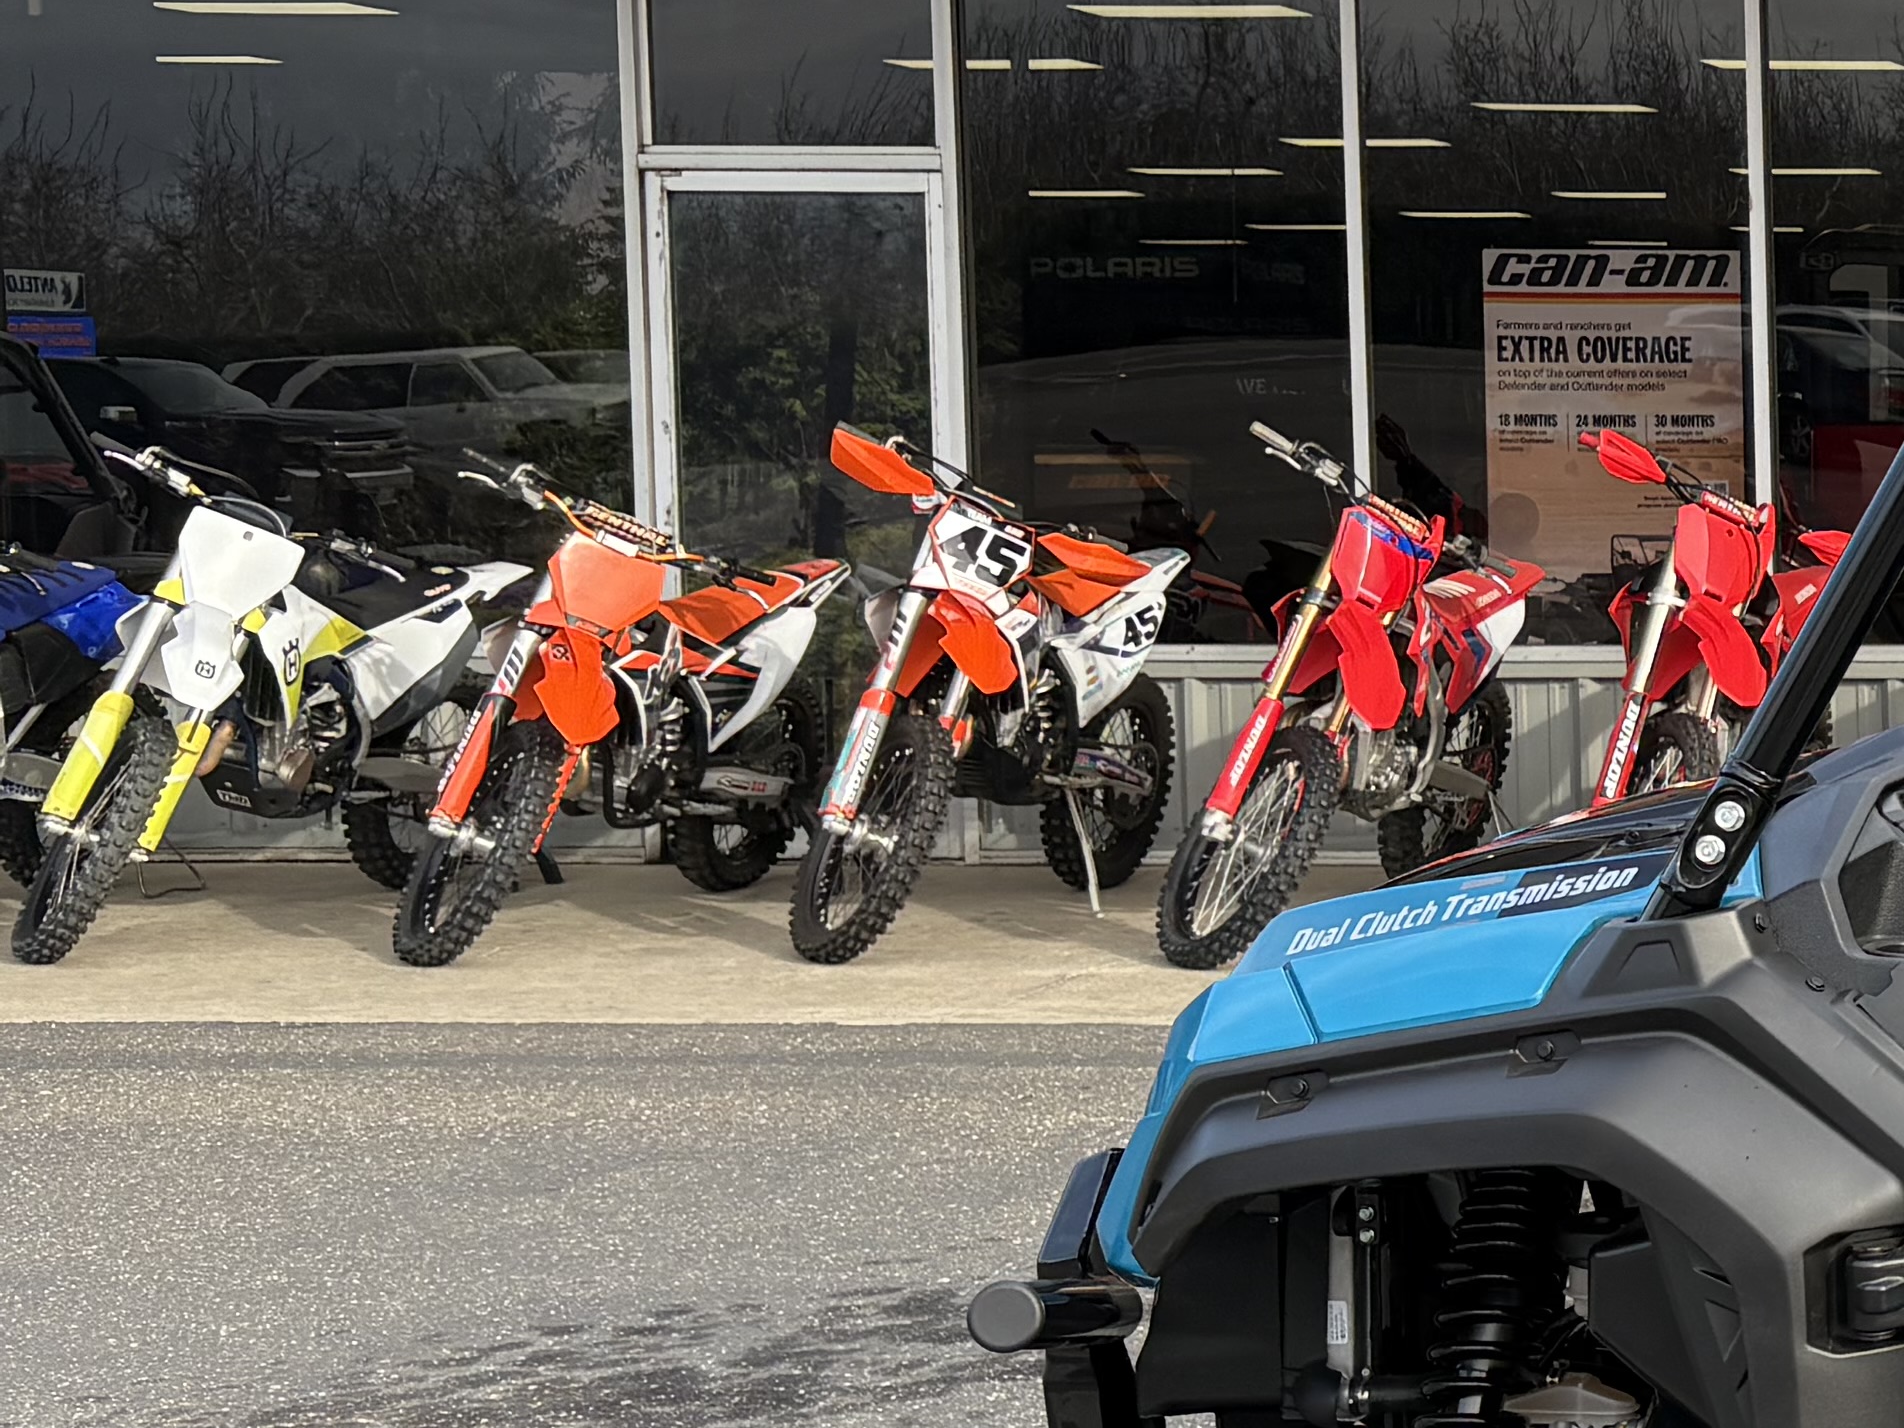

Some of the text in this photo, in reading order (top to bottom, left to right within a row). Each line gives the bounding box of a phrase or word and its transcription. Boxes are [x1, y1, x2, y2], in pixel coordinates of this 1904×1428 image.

[1029, 256, 1200, 279] POLARIS
[1542, 320, 1563, 331] and
[1497, 335, 1693, 363] EXTRA COVERAGE
[1498, 414, 1558, 428] 18 MONTHS
[1576, 414, 1637, 428] 24 MONTHS
[1654, 414, 1715, 428] 30 MONTHS
[942, 525, 1028, 588] 45
[1123, 603, 1159, 648] 45
[1229, 714, 1268, 788] DUNLOP
[1604, 699, 1641, 799] DUNLOP
[1286, 866, 1639, 956] Dual Clutch Transmission
